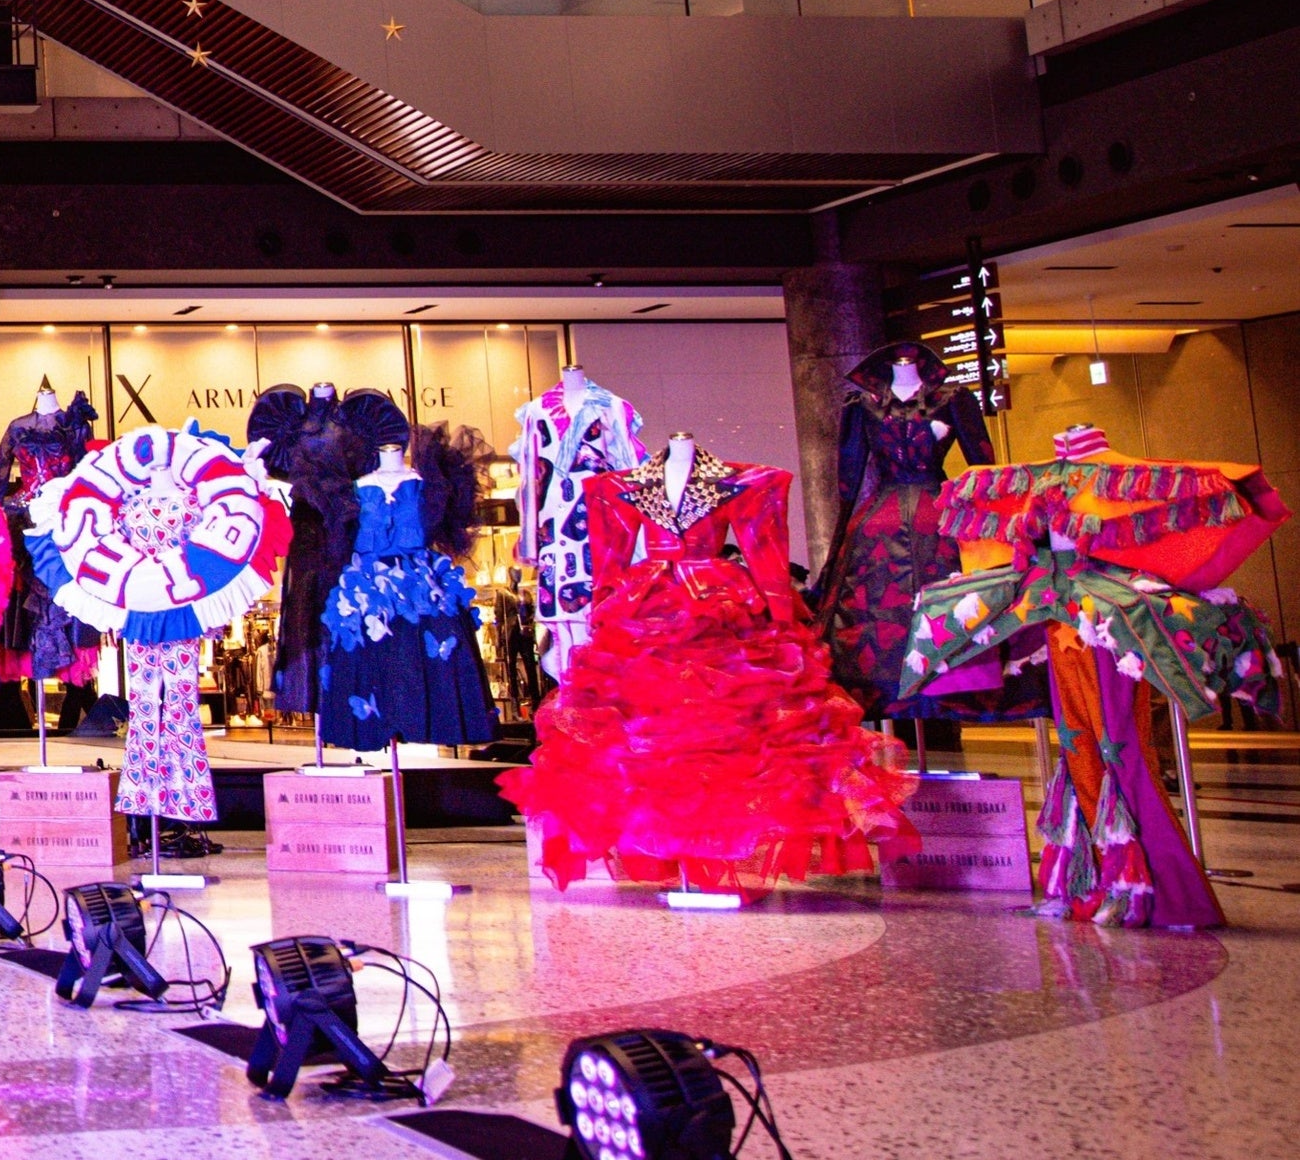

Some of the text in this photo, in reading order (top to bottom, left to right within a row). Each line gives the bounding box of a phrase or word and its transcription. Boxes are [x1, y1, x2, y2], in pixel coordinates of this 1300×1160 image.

[25, 791, 98, 801] GRAND FRONT OSAKA
[294, 793, 371, 804] GRAND FRONT OSAKA
[977, 802, 1007, 814] OSAKA
[26, 837, 99, 847] GRAND FRONT OSAKA
[296, 843, 374, 855] GRAND FRONT OSAKA
